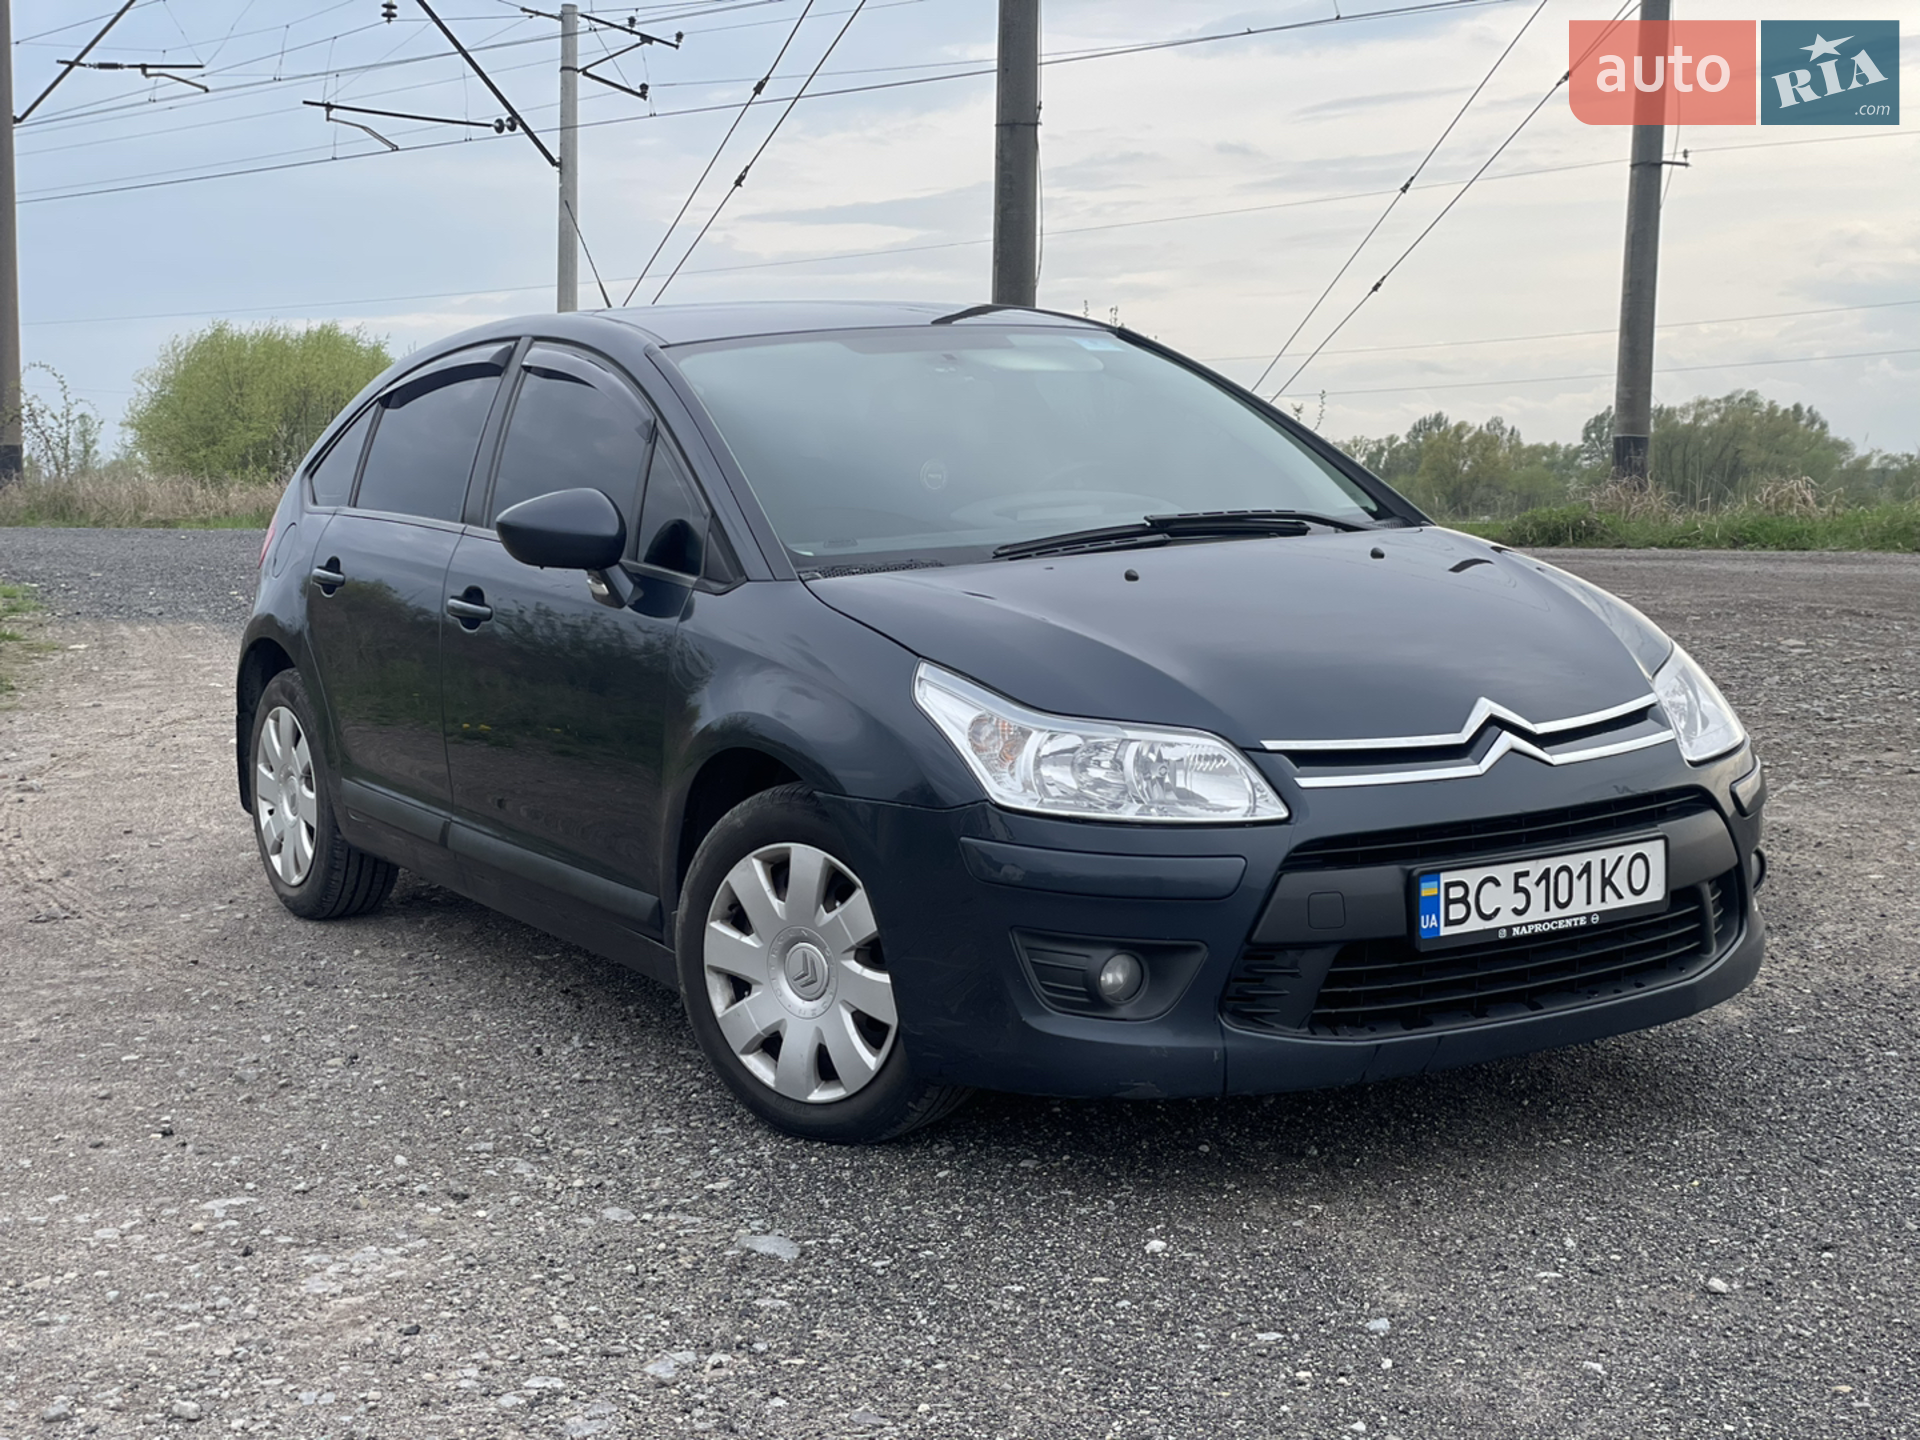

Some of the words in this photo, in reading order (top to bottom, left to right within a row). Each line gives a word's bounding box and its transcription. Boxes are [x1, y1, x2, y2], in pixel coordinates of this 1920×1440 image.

[1443, 875, 1502, 927] BC
[1421, 913, 1438, 929] UA
[1512, 915, 1587, 936] NAPROCENTE
